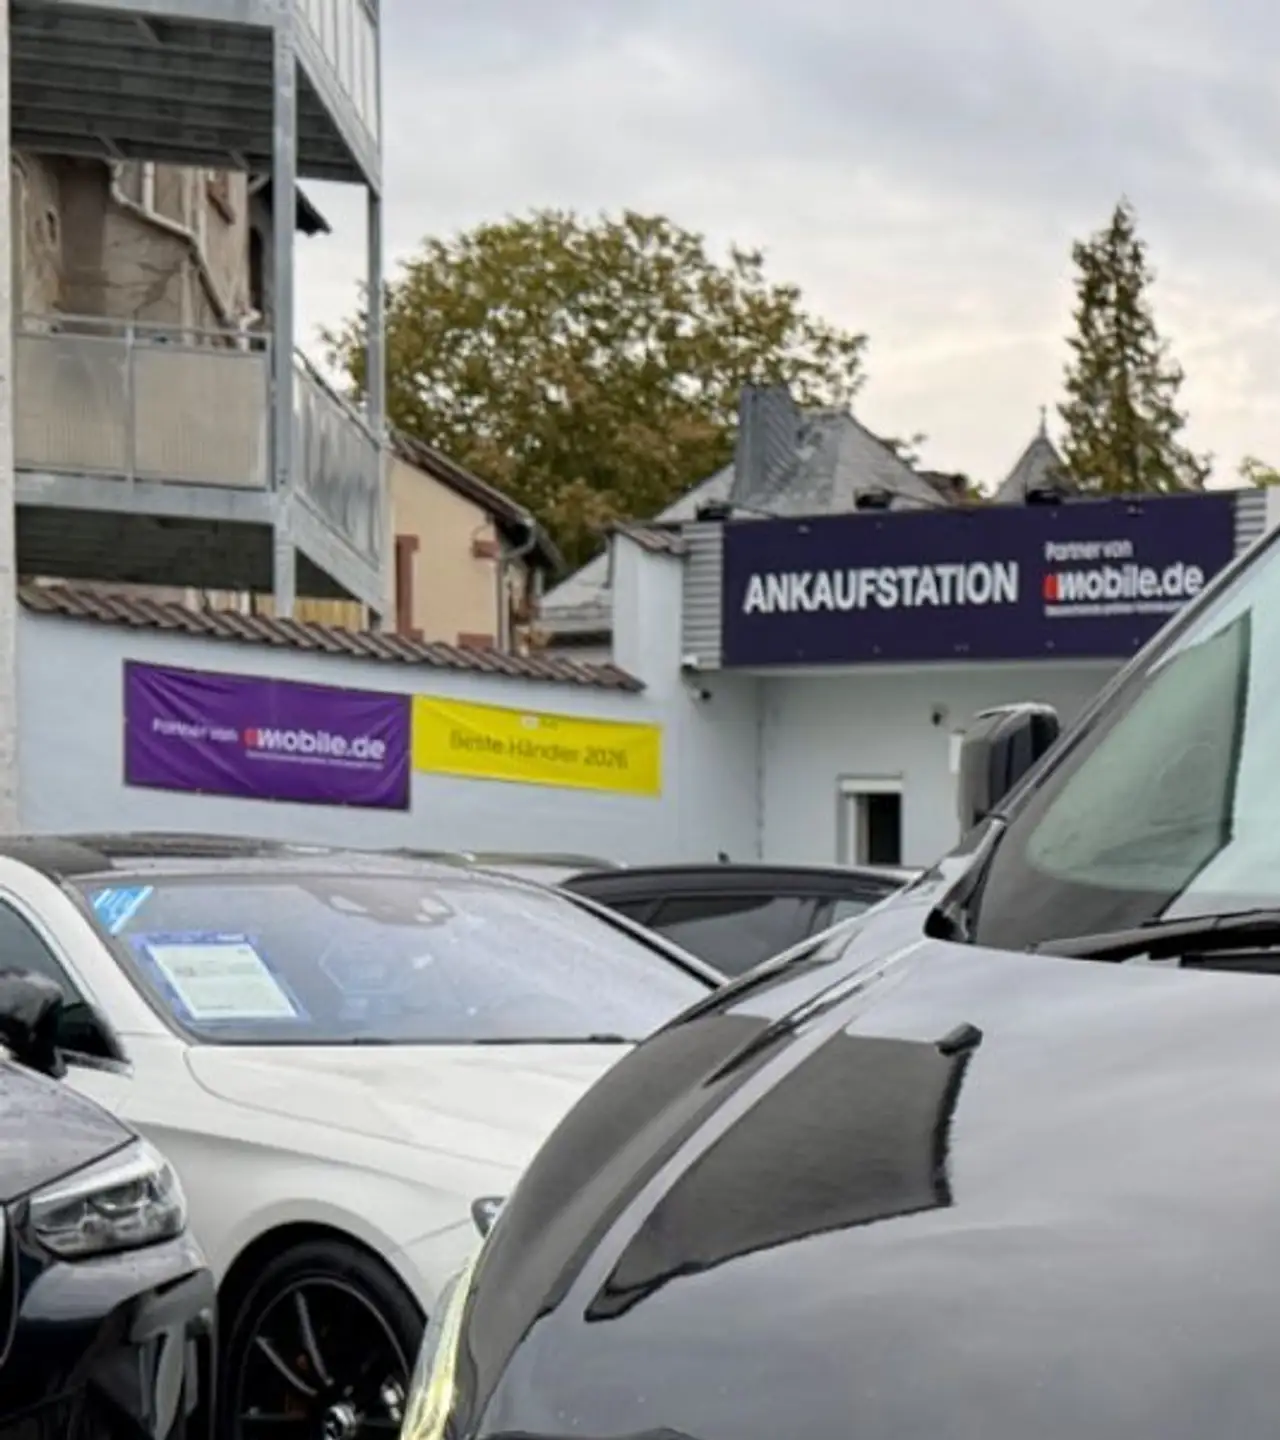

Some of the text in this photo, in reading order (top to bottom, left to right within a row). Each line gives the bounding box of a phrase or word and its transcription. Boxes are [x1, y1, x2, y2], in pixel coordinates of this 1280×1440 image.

[1044, 539, 1134, 562] Partner von
[744, 561, 1019, 614] ANKAUFSTATION
[1056, 560, 1204, 600] mobile.de
[256, 728, 386, 760] mobile.de
[450, 729, 504, 755] Beste
